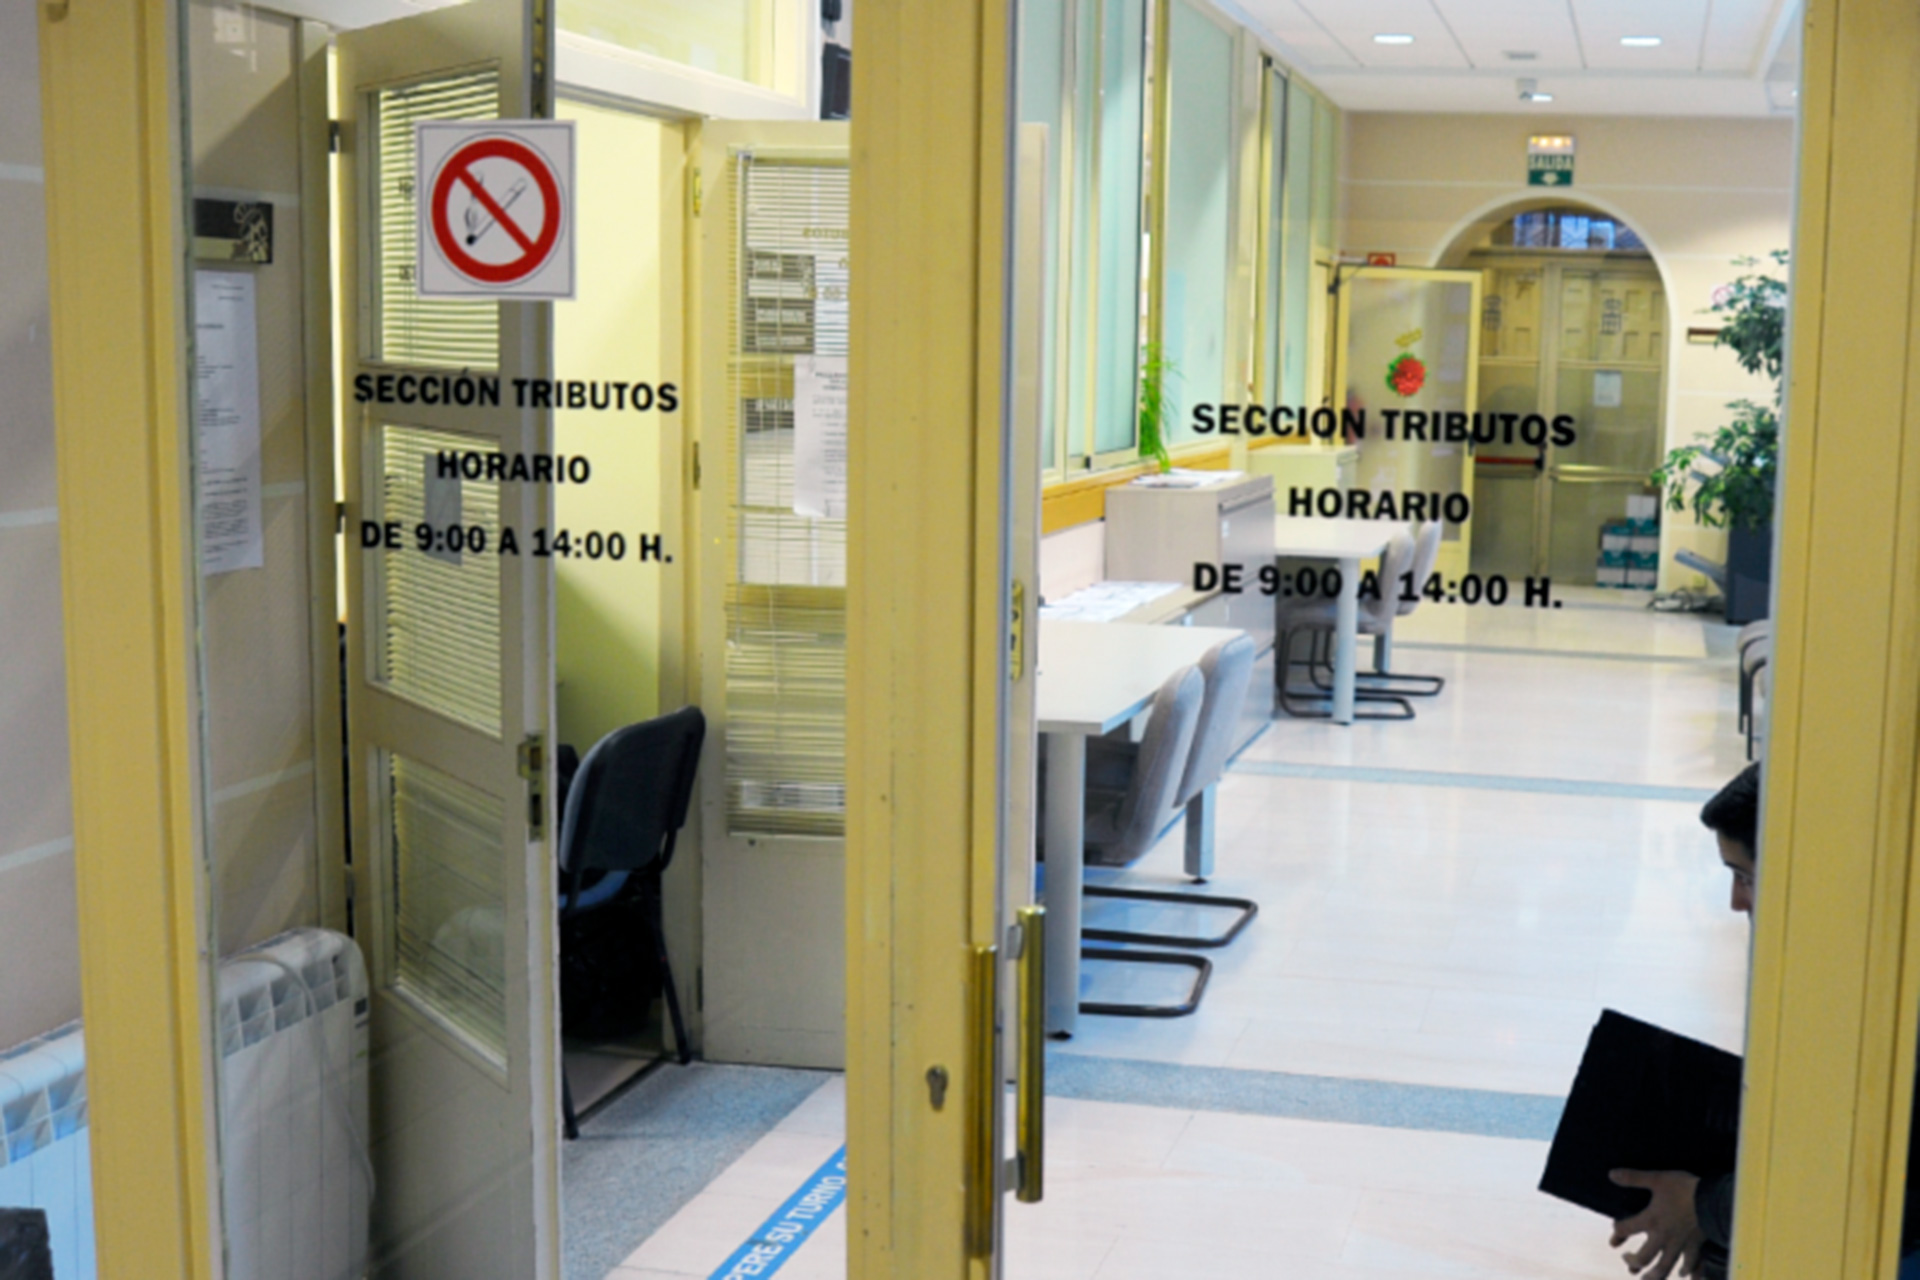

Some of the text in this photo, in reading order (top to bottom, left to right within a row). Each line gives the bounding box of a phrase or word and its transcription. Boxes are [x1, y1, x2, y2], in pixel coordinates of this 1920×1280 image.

[354, 368, 679, 412] SECCIÓN TRIBUTOS
[1192, 396, 1577, 447] SECCIÓN TRIBUTOS
[437, 451, 591, 484] HORARIO
[1288, 487, 1470, 524] HORARIO
[360, 520, 673, 563] DE 9:00 A 14:00 H.
[1193, 563, 1563, 608] DE 9:00 A 14:00 H.
[784, 1176, 846, 1220] TURNO
[765, 1220, 804, 1243] SU
